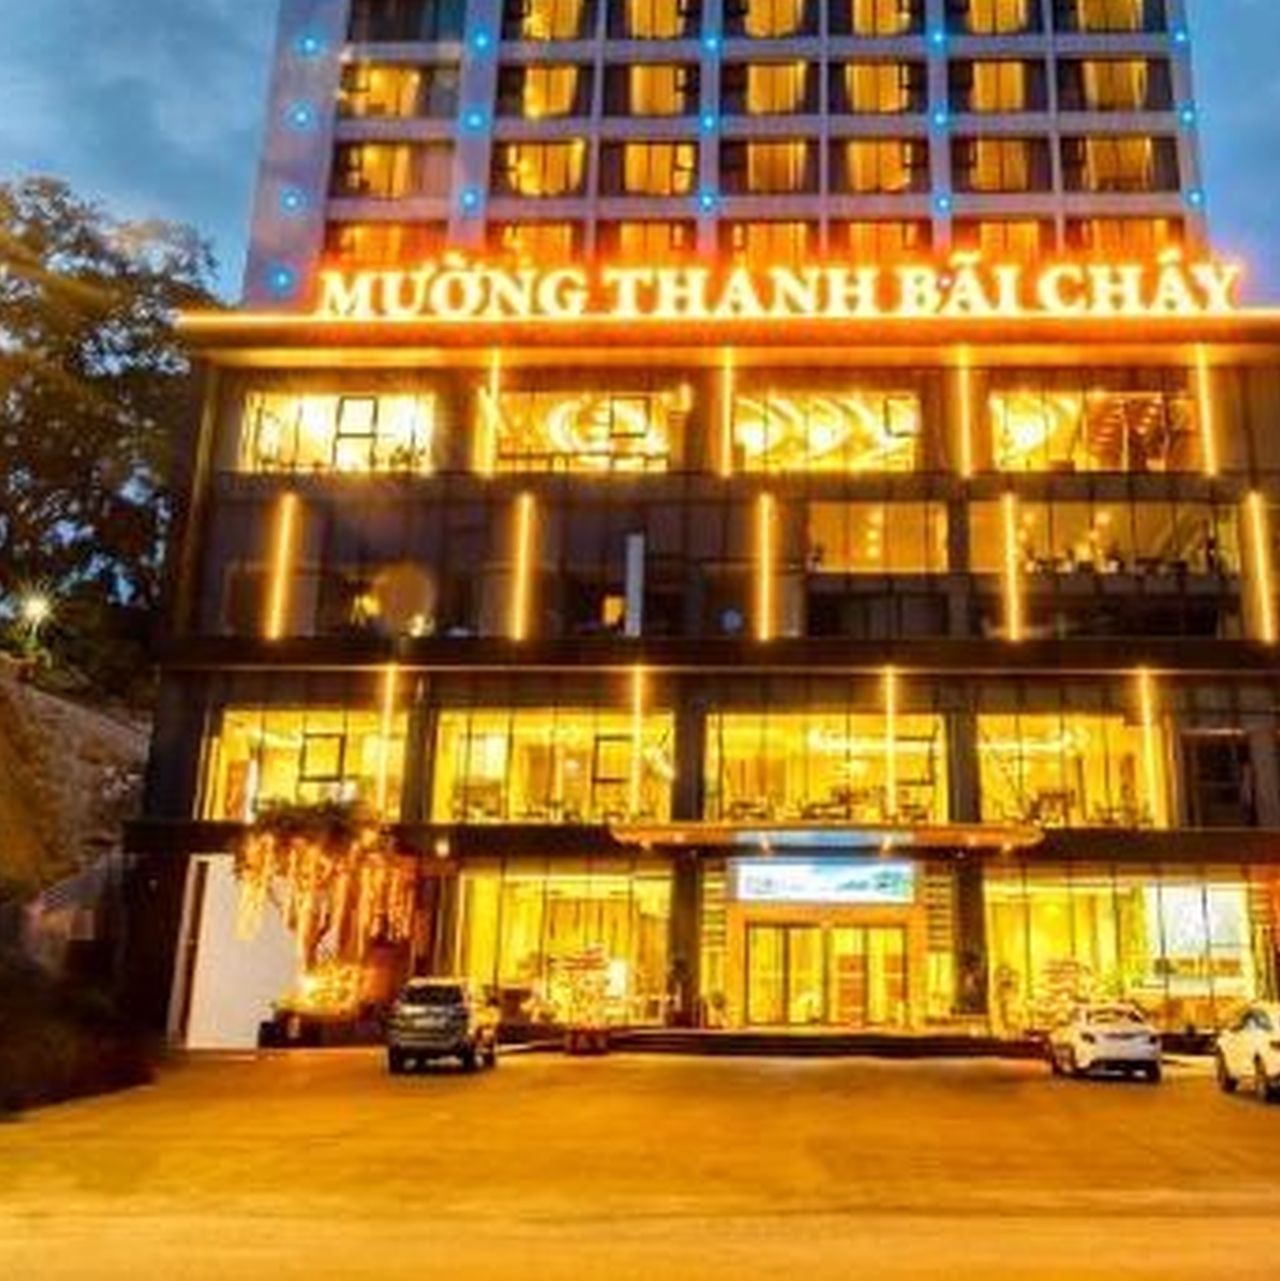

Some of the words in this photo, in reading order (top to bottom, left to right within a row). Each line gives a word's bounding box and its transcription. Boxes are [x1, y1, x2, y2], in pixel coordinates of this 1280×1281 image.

[601, 265, 880, 317] THANH
[894, 250, 1021, 316] BÃI
[1036, 248, 1239, 316] CHÁY
